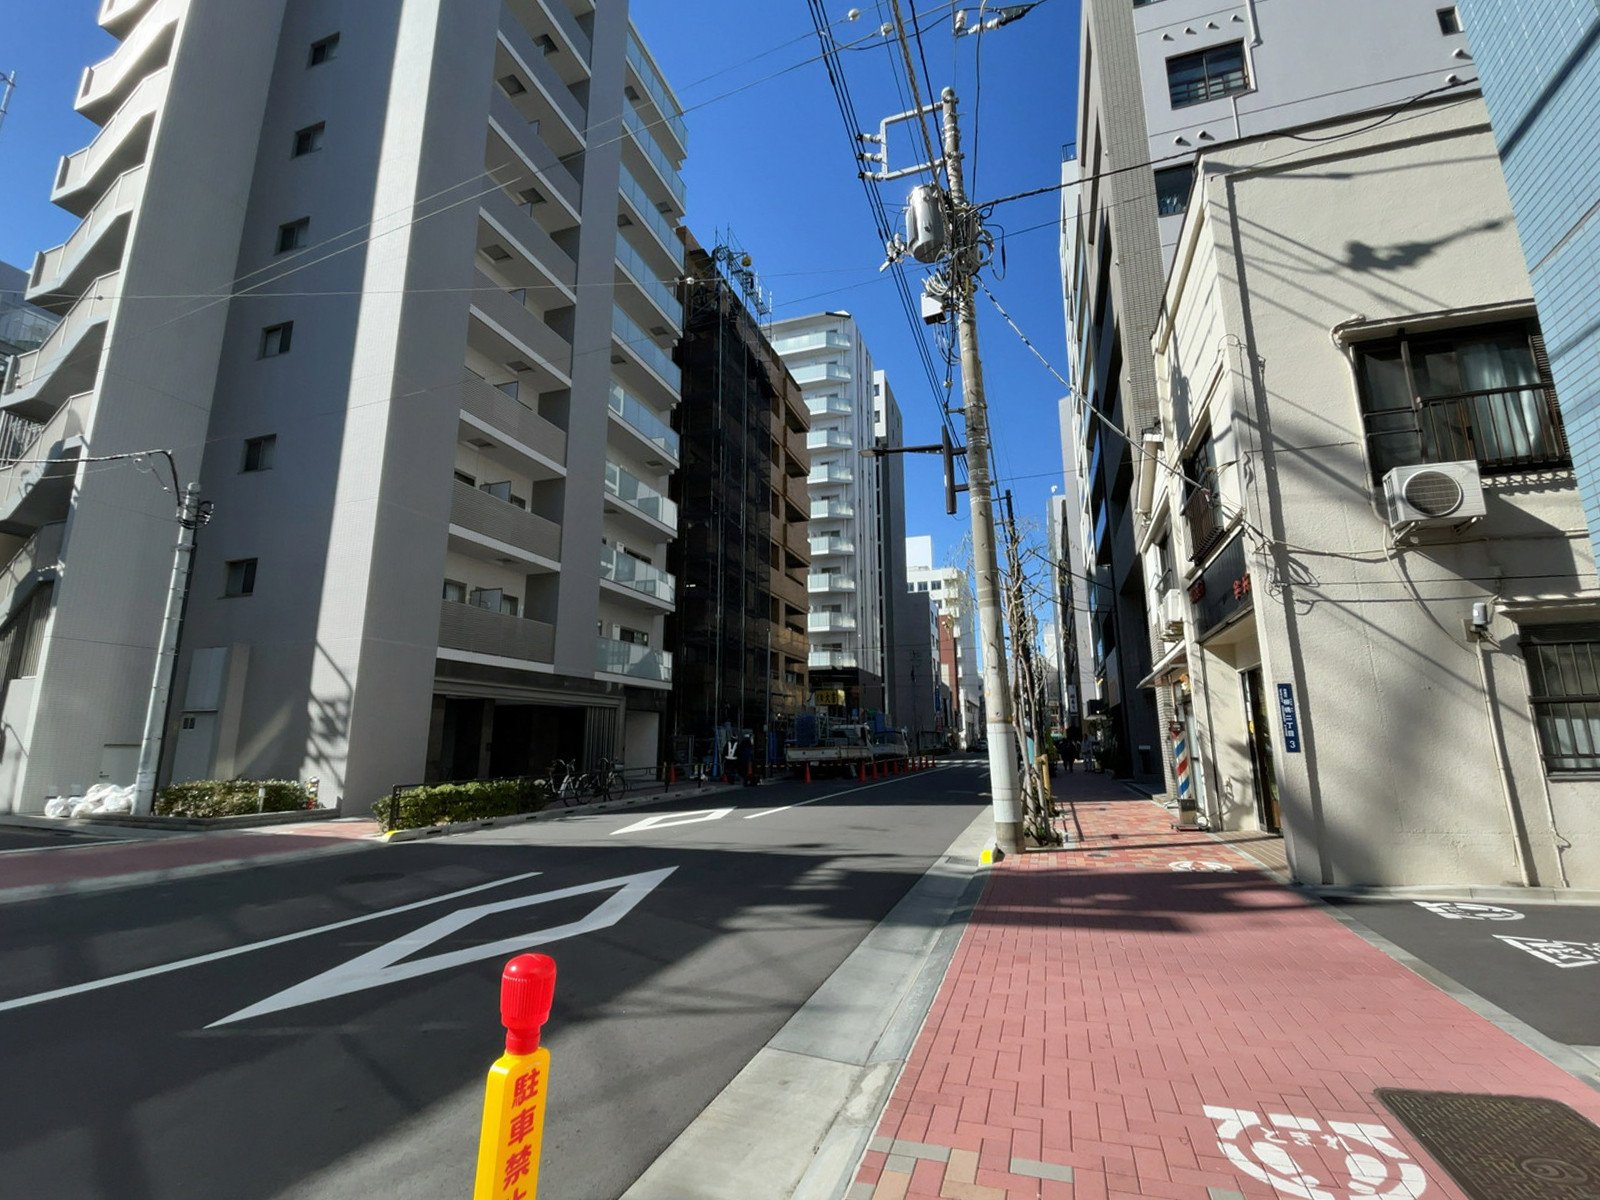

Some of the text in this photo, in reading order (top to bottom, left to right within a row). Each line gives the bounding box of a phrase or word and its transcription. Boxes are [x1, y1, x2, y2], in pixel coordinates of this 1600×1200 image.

[1289, 740, 1296, 749] 3
[1260, 1126, 1353, 1152] とまれ
